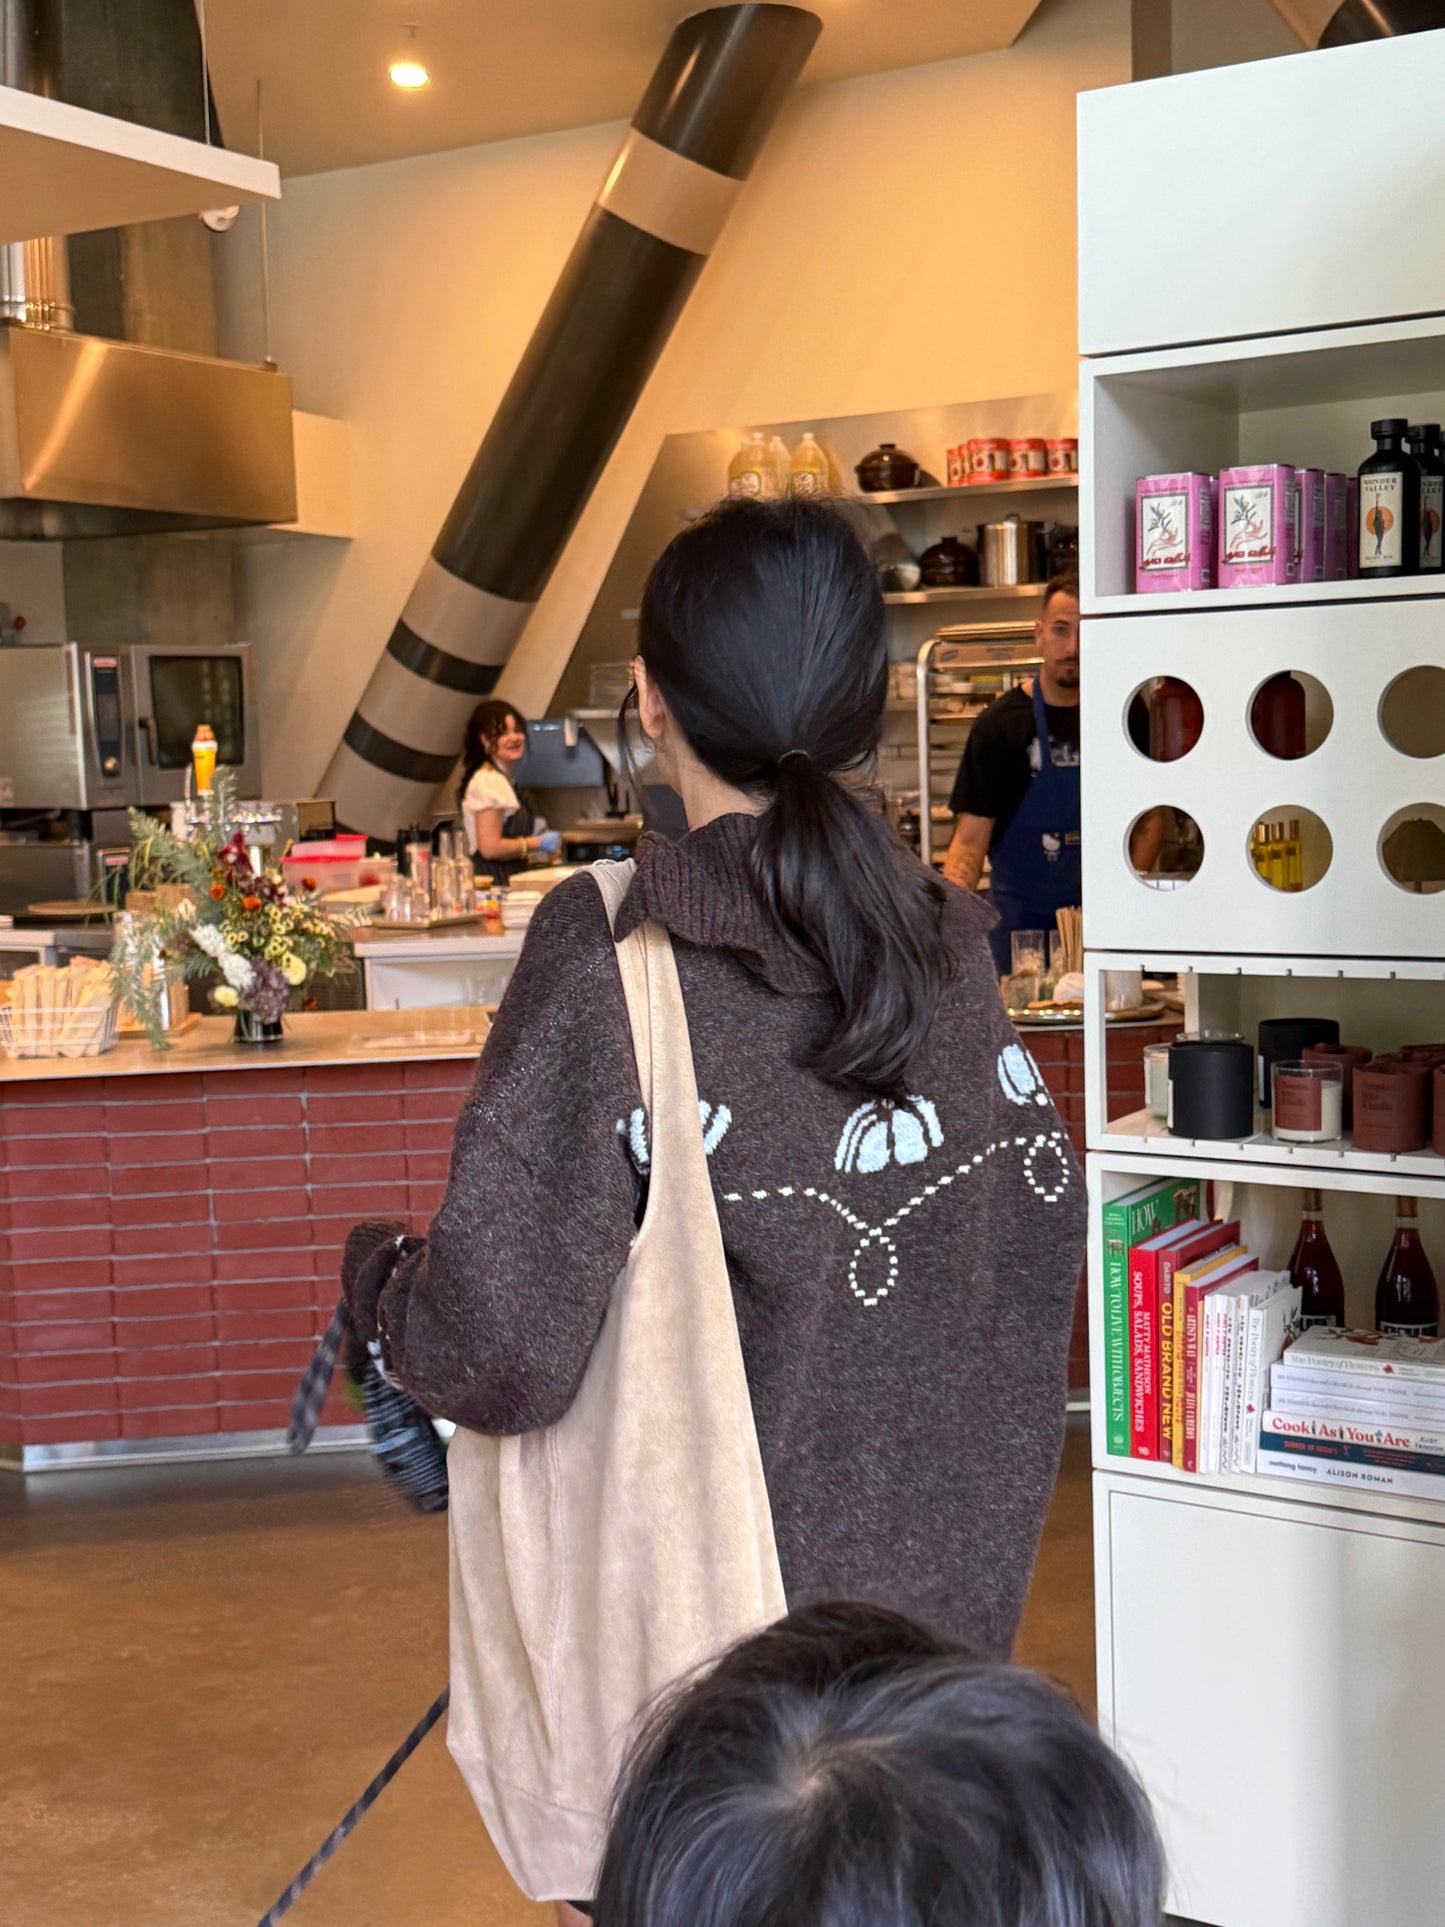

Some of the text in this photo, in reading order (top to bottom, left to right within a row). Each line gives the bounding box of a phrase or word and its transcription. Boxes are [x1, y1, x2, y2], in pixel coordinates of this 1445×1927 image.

[1364, 477, 1397, 485] WONDER
[1163, 1262, 1172, 1294] DABITO
[1110, 1262, 1124, 1421] HOW TO LIVE WITH OBJECTS
[1133, 1271, 1144, 1432] SOUPS, SALADS, SANDWICHES
[1143, 1312, 1152, 1395] MATTY MATHESON
[1161, 1302, 1173, 1440] OLD BRAND NEW
[1272, 1417, 1411, 1448] Cook As You Are
[1326, 1468, 1394, 1484] ALISON ROMAN
